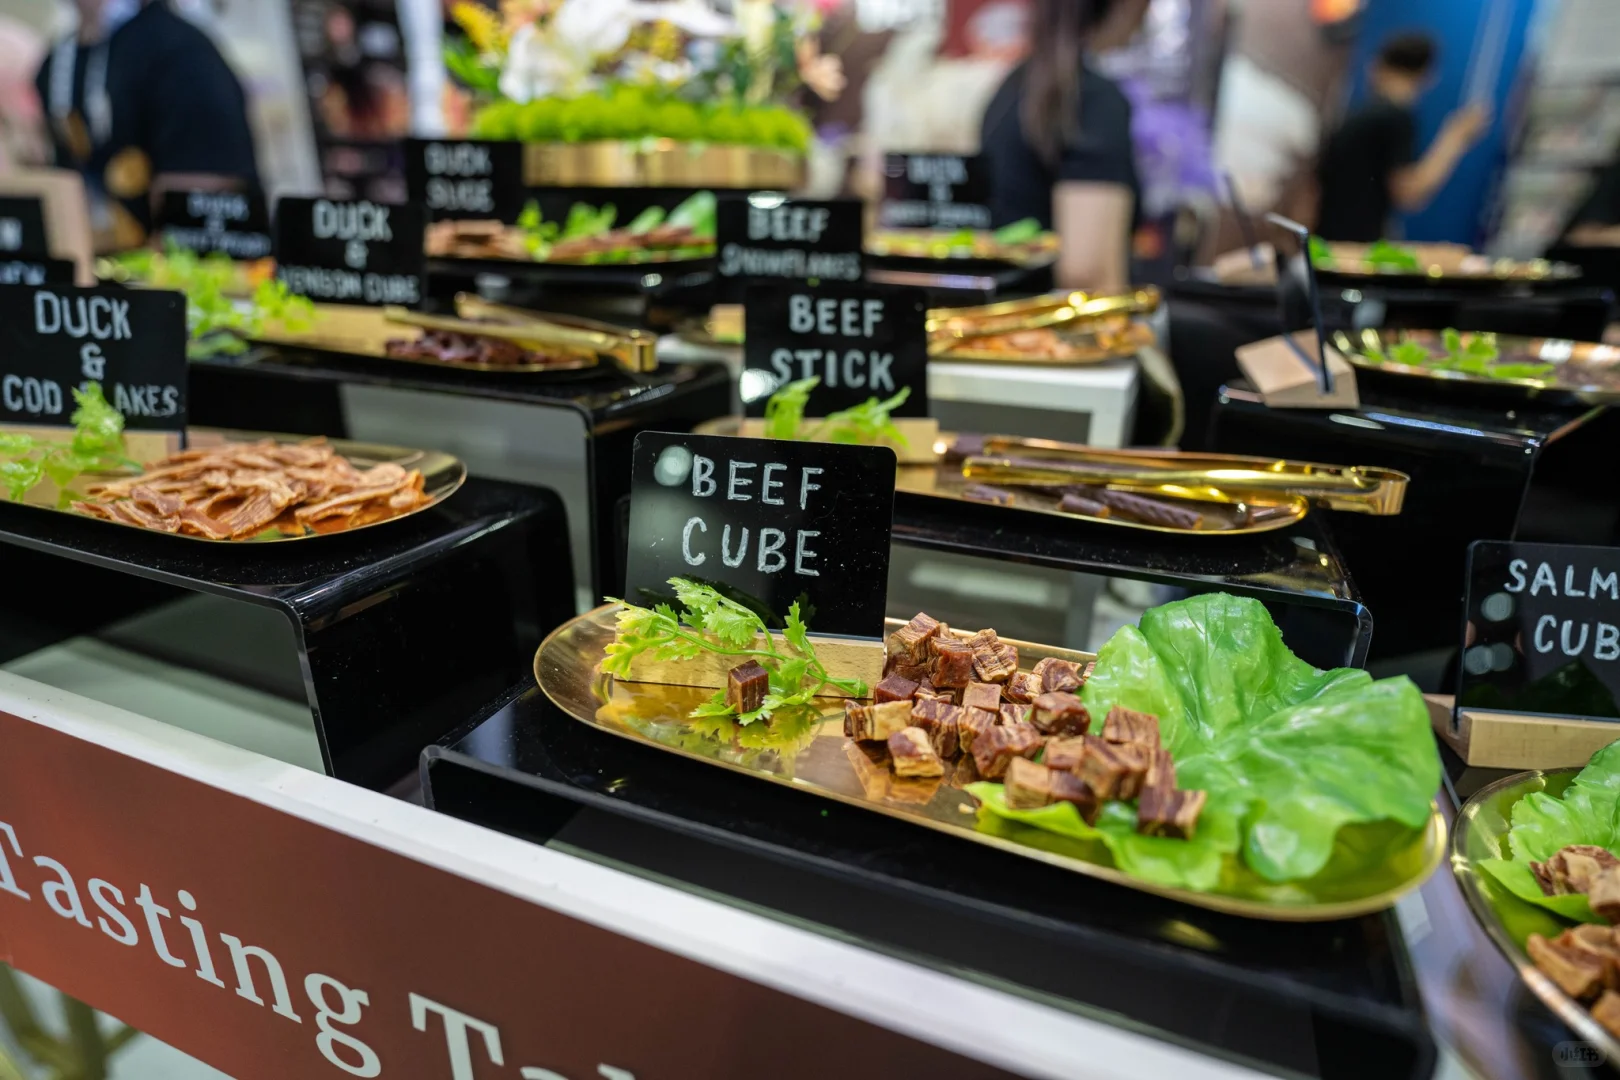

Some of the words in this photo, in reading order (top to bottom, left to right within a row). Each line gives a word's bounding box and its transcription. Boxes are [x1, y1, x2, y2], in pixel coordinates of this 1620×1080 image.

[312, 199, 393, 242] DUCK
[748, 205, 831, 243] BEEF
[364, 272, 420, 304] CUBE
[34, 290, 132, 340] DUCK
[788, 293, 885, 338] BEEF
[80, 342, 106, 380] &
[770, 347, 896, 392] STICK
[2, 374, 63, 415] COD
[80, 381, 179, 418] AKES
[692, 453, 825, 510] BEEF
[682, 516, 821, 577] CUBE
